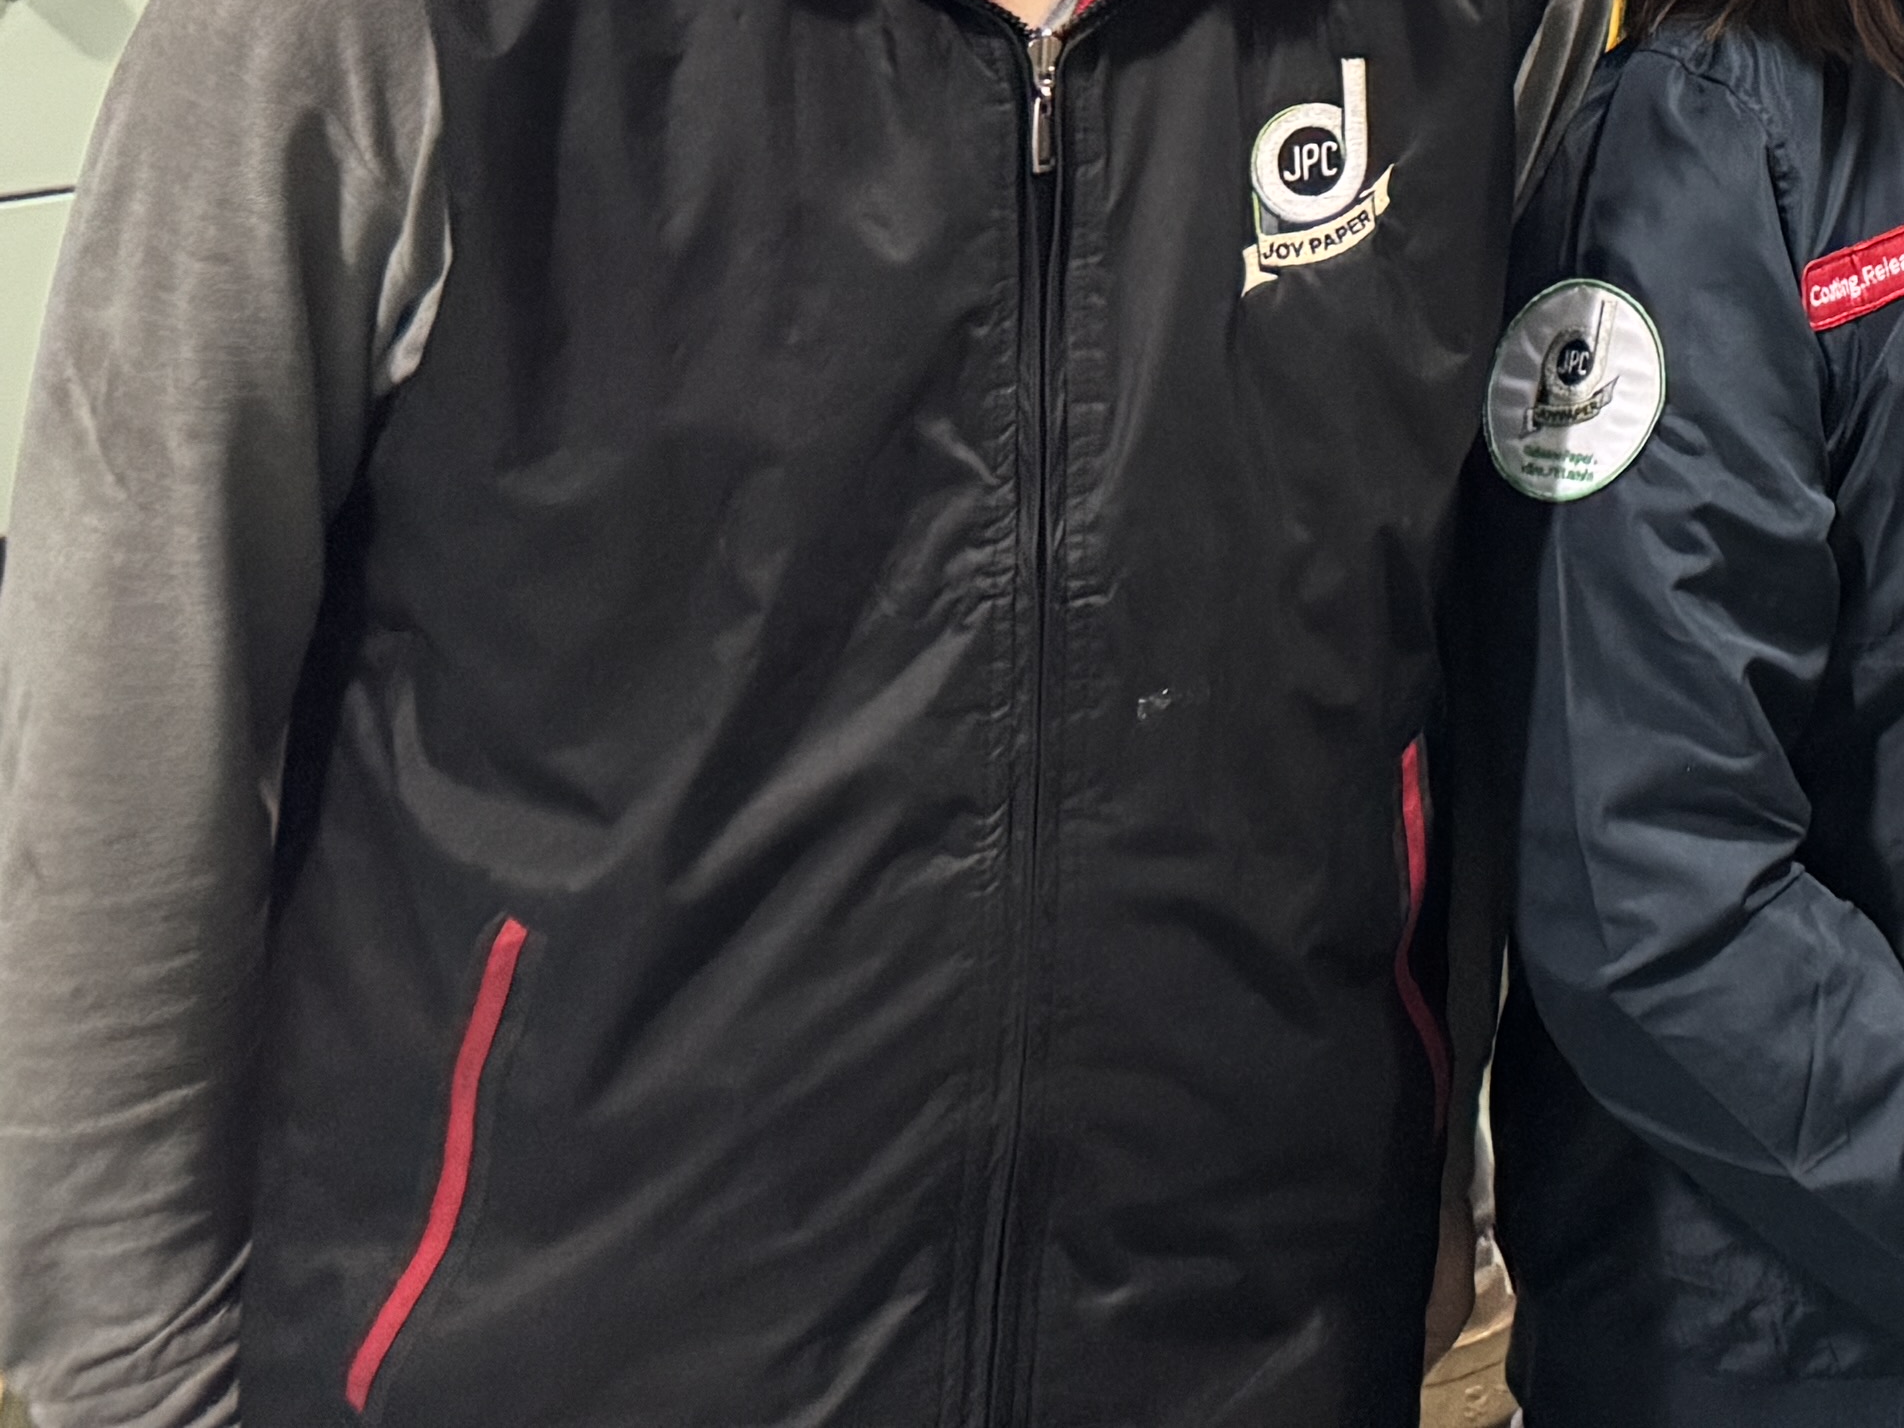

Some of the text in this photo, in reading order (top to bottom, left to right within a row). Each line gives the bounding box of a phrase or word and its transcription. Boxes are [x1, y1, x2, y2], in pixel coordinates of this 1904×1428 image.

[1283, 141, 1338, 182] JPC
[1309, 210, 1371, 254] PAPER
[1557, 350, 1590, 375] JPC
